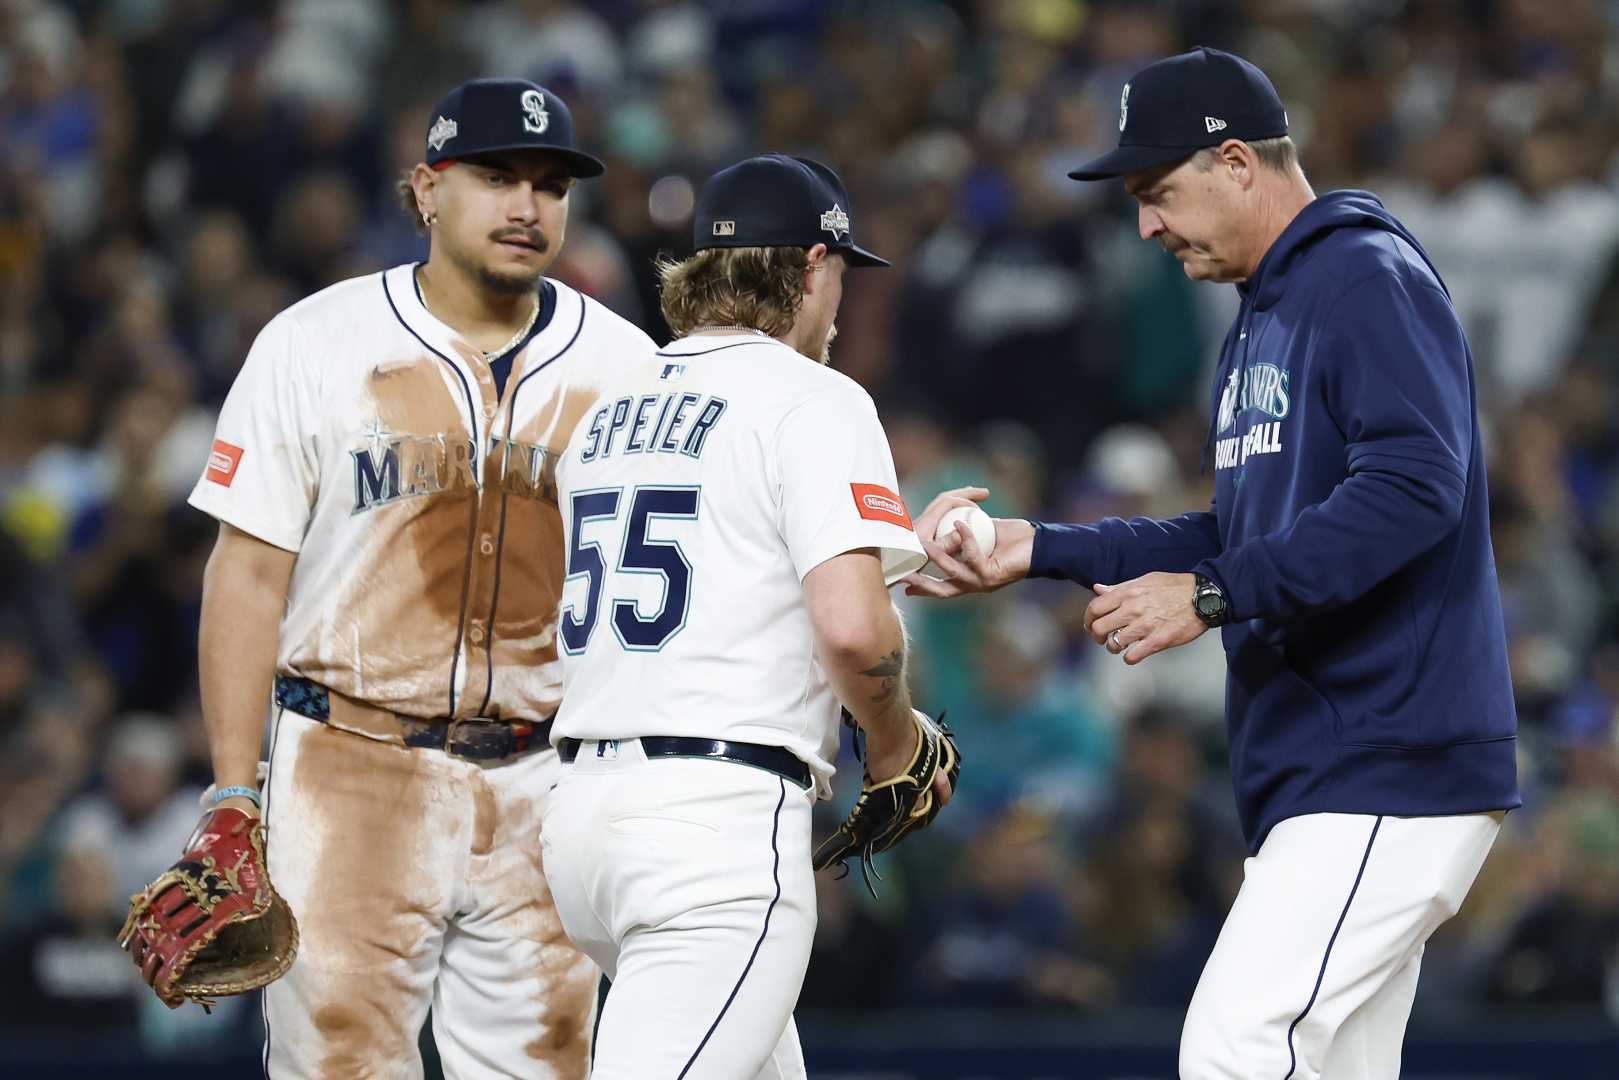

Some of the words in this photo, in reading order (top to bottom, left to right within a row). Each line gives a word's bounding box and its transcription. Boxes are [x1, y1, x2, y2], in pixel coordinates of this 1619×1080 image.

[520, 89, 549, 134] S
[581, 392, 728, 464] SPEIER
[558, 485, 701, 656] 55
